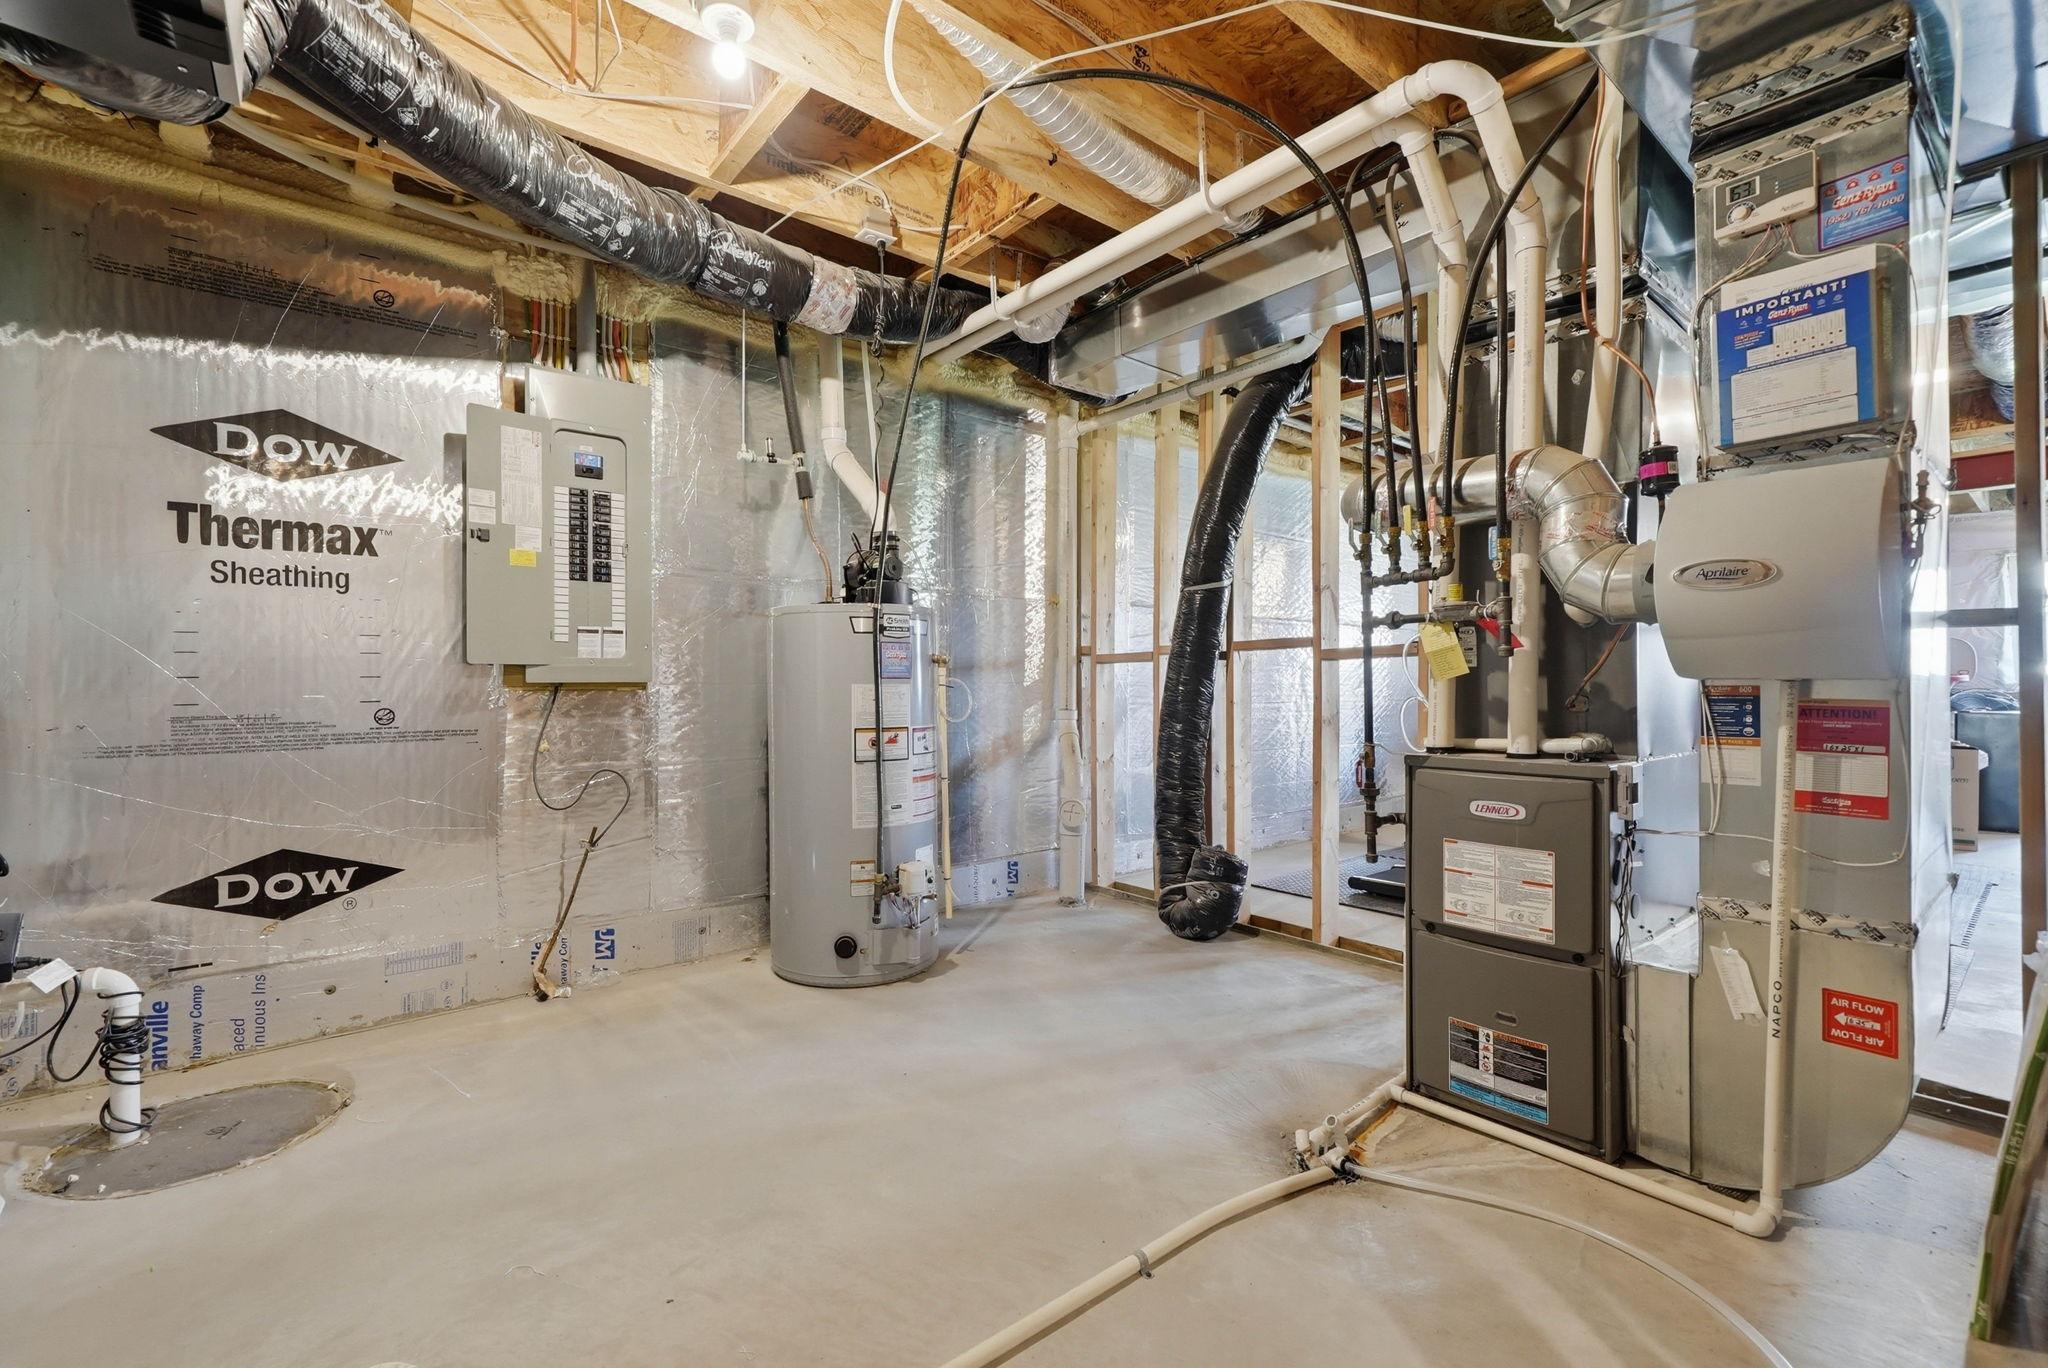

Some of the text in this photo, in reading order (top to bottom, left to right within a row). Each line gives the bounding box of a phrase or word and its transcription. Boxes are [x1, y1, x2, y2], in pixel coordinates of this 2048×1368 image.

[1735, 279, 1846, 318] IMPORTANT!
[210, 559, 350, 594] Sheathing
[1475, 804, 1510, 816] LENNOX
[1772, 980, 1782, 1038] NAPCO
[1830, 997, 1885, 1016] AIR FLOW
[1830, 1028, 1884, 1047] AIR FLOW
